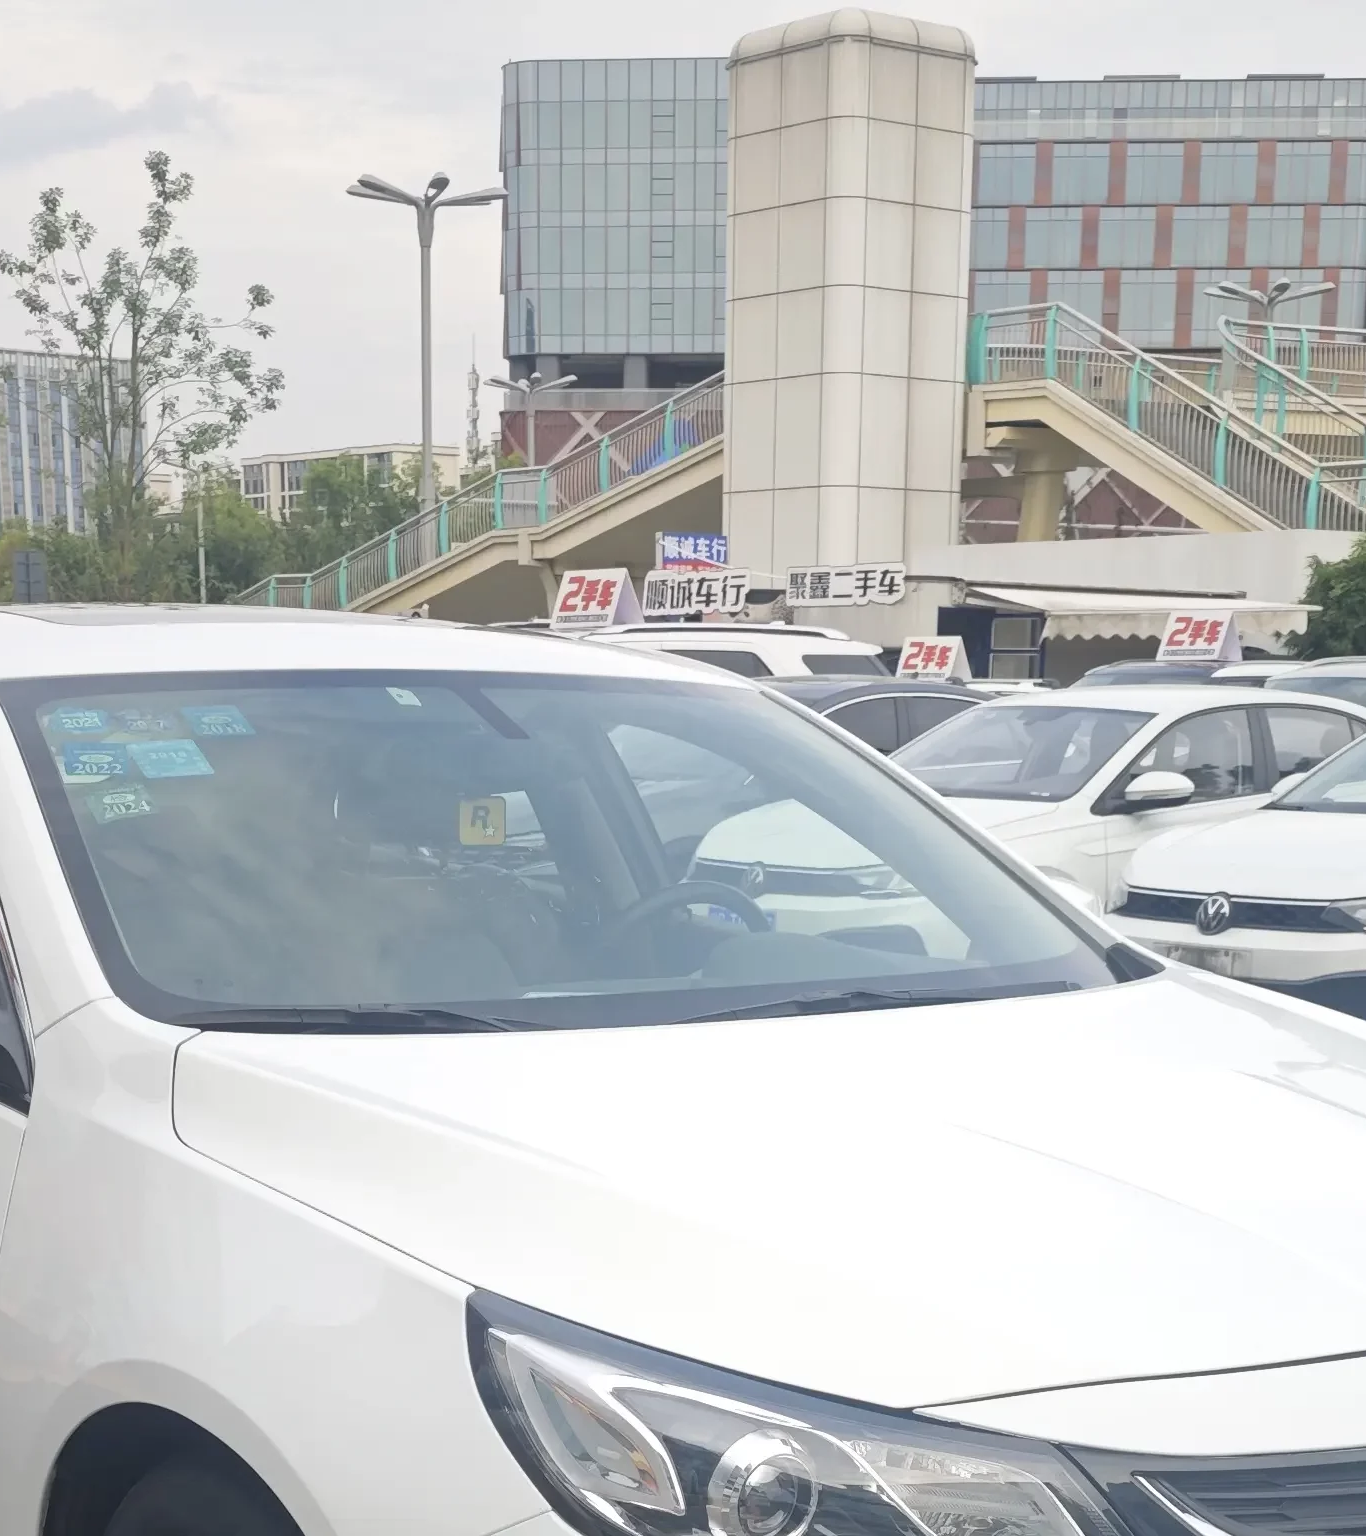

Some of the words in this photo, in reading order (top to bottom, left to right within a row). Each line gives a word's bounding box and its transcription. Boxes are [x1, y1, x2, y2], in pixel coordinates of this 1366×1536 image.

[558, 575, 618, 613] 2手车
[645, 575, 747, 610] 顺诚车行
[788, 569, 903, 600] 聚鑫二手车
[1166, 616, 1224, 647] 2手车
[902, 641, 953, 671] 2手车
[71, 763, 124, 774] 2022
[104, 800, 152, 819] 2024
